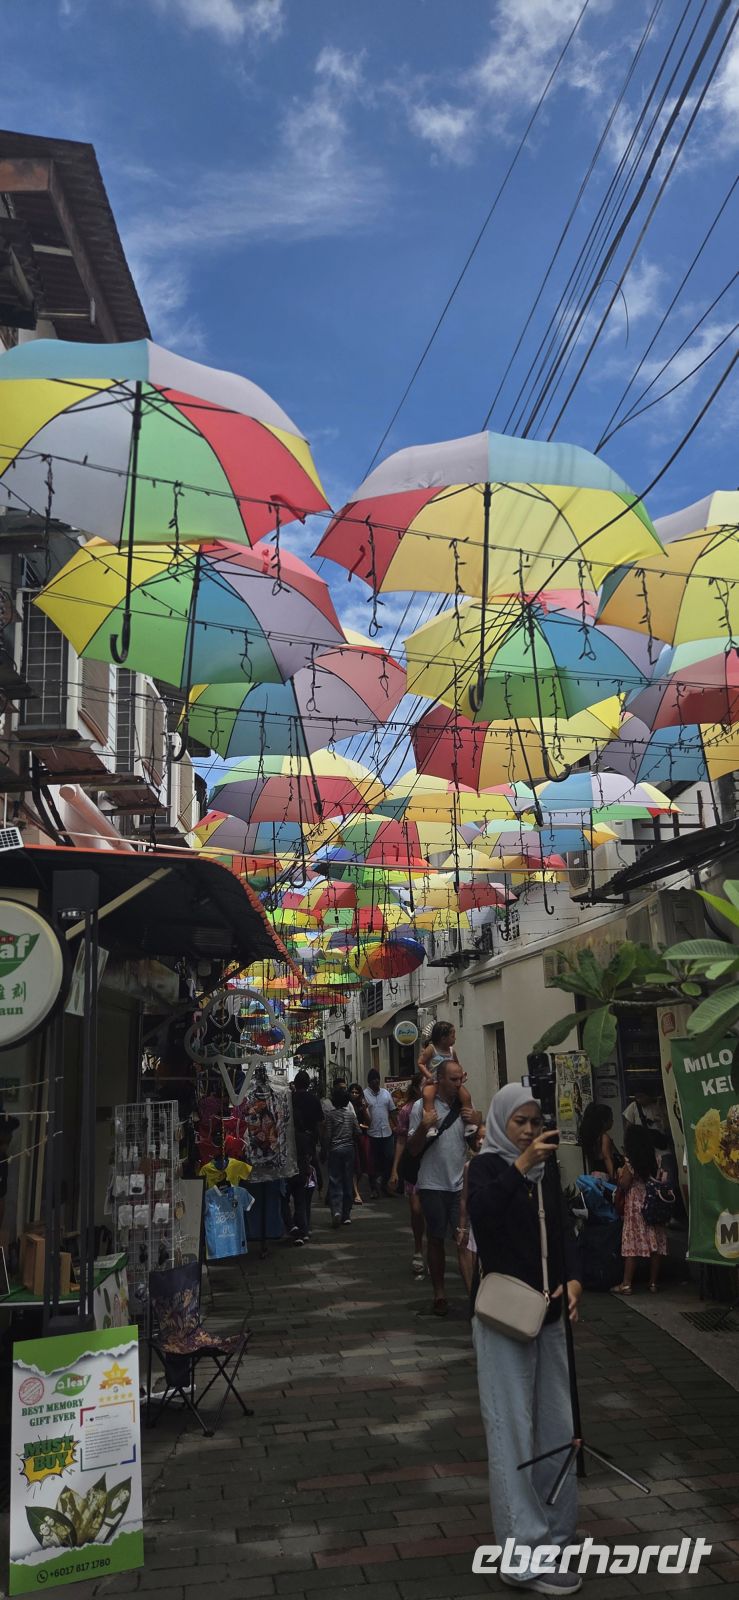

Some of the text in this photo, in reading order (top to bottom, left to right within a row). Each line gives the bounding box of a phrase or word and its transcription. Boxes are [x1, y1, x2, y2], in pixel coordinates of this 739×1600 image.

[683, 1049, 733, 1073] MILO
[67, 1375, 87, 1388] leaf
[22, 1399, 84, 1416] BEST MEMORY
[30, 1416, 51, 1427] GIFT
[53, 1412, 76, 1423] EVER
[24, 1435, 74, 1458] MUST
[33, 1452, 68, 1472] BUY
